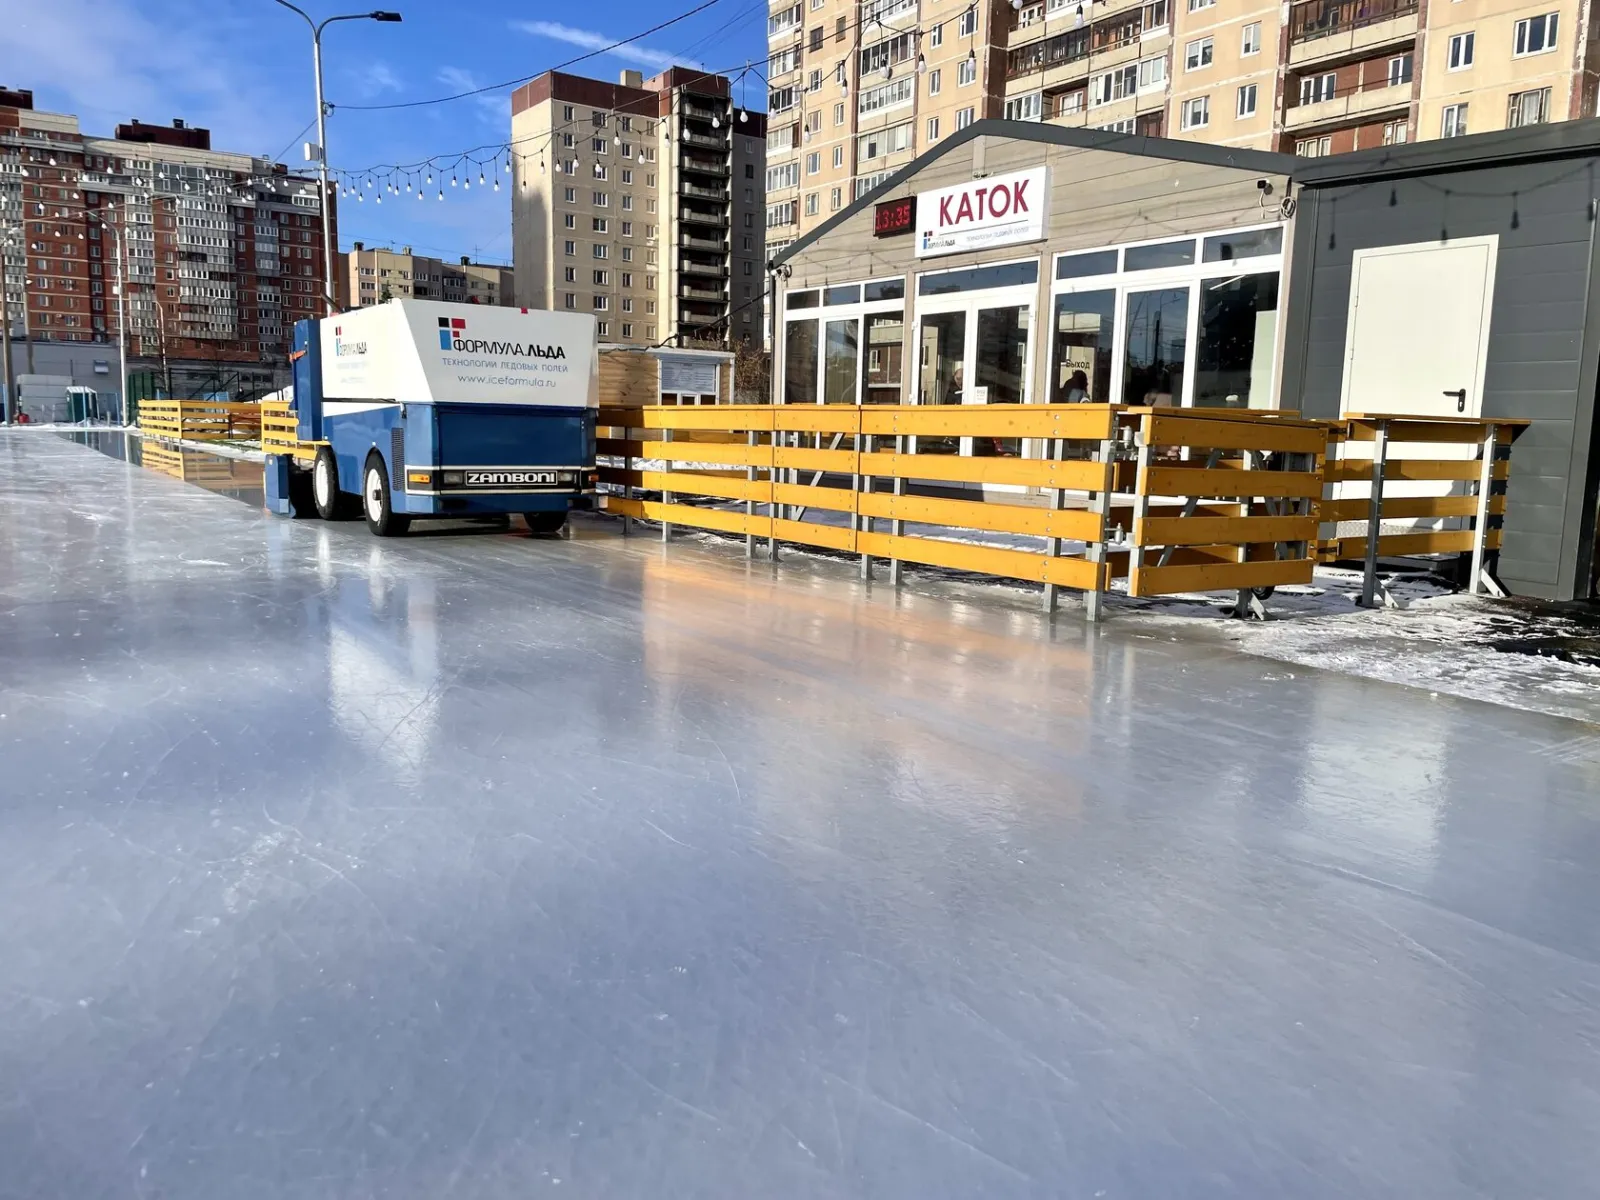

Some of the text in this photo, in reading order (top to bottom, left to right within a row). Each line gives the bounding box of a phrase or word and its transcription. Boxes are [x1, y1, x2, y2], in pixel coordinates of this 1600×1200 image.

[939, 179, 1030, 227] КАТОК
[876, 204, 911, 230] 13:35
[442, 357, 569, 373] ТЕХНОЛОГИИ ЛЕДОВЫХ ПОЛЕЙ
[457, 374, 557, 388] www.iceformula.ru
[468, 472, 555, 483] ZAMBONI
